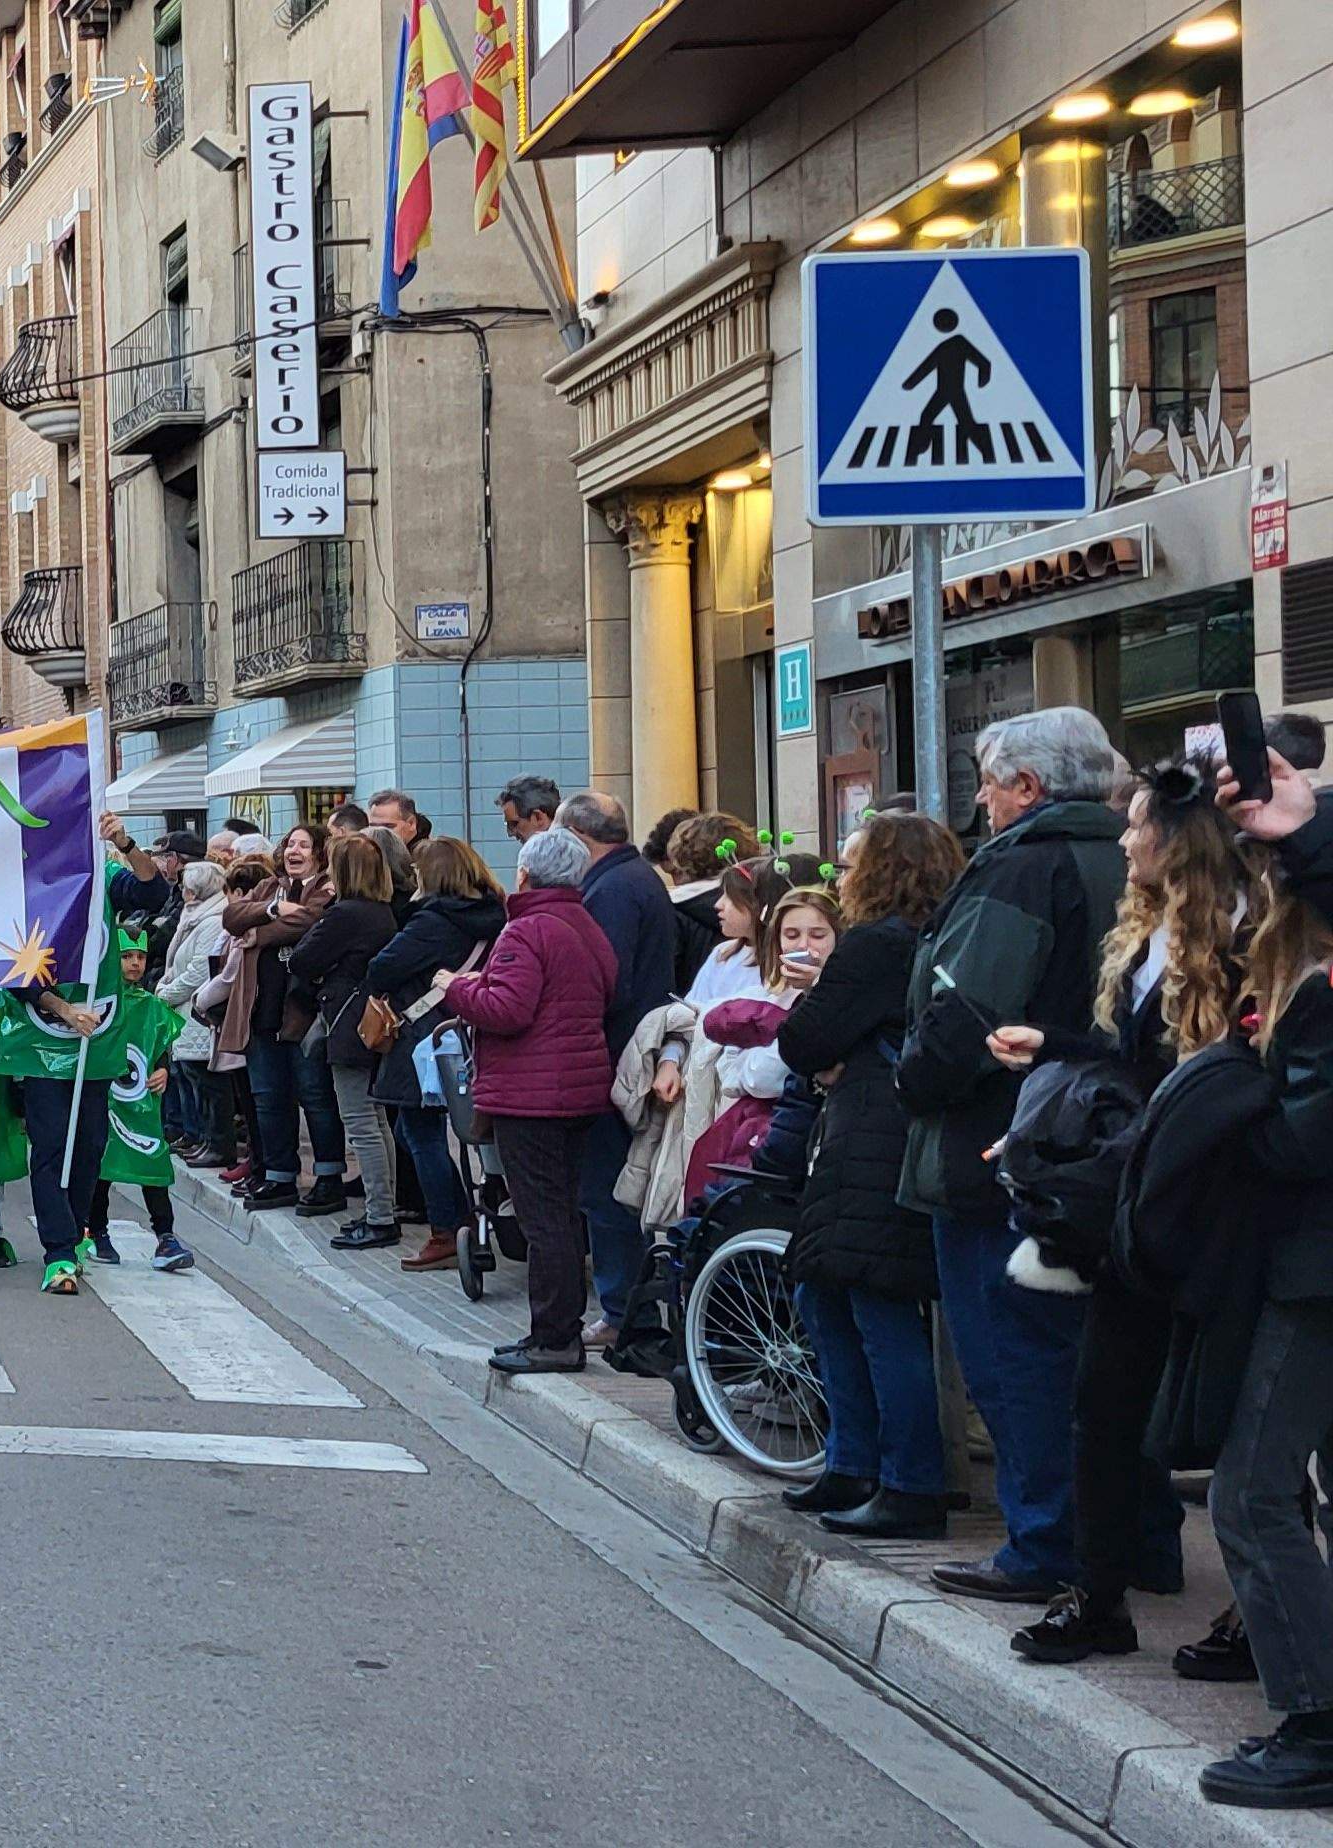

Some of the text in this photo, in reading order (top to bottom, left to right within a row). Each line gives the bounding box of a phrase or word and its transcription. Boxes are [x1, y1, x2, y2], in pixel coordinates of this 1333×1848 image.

[261, 96, 303, 435] Gastro Caserío
[275, 463, 328, 479] Comida
[263, 482, 340, 498] Tradicional
[1254, 505, 1285, 525] Alarma
[425, 626, 462, 637] LIZANA
[784, 658, 803, 703] H
